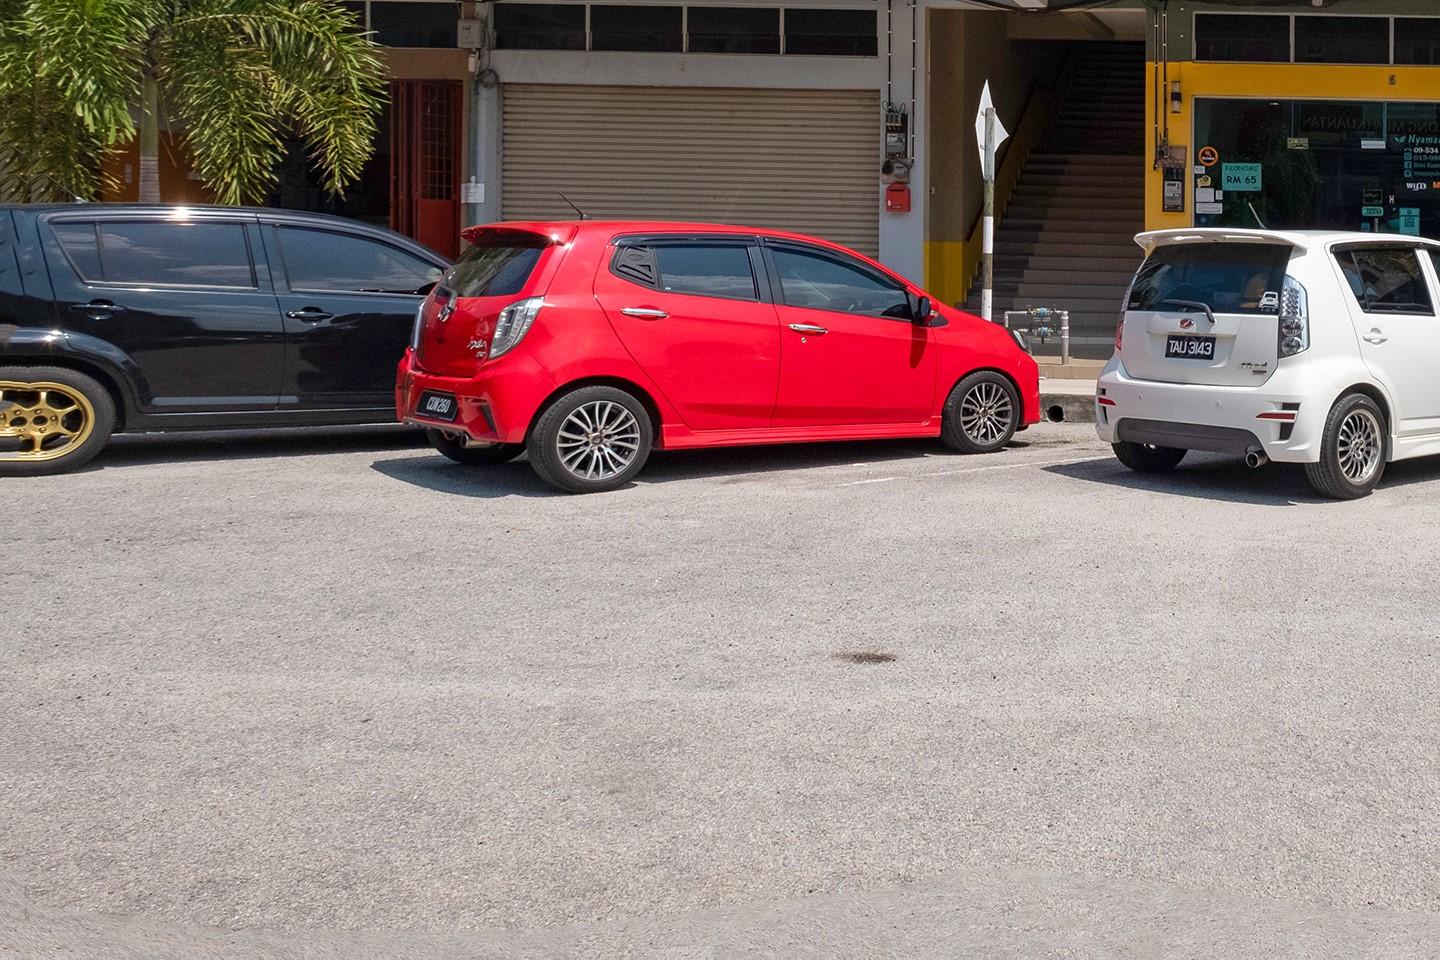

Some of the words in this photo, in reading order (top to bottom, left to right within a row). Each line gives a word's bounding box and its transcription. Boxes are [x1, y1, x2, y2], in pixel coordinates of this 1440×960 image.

[1226, 176, 1242, 184] RM
[1244, 176, 1257, 184] 65
[1169, 340, 1188, 353] TAU
[1188, 341, 1213, 355] 3143
